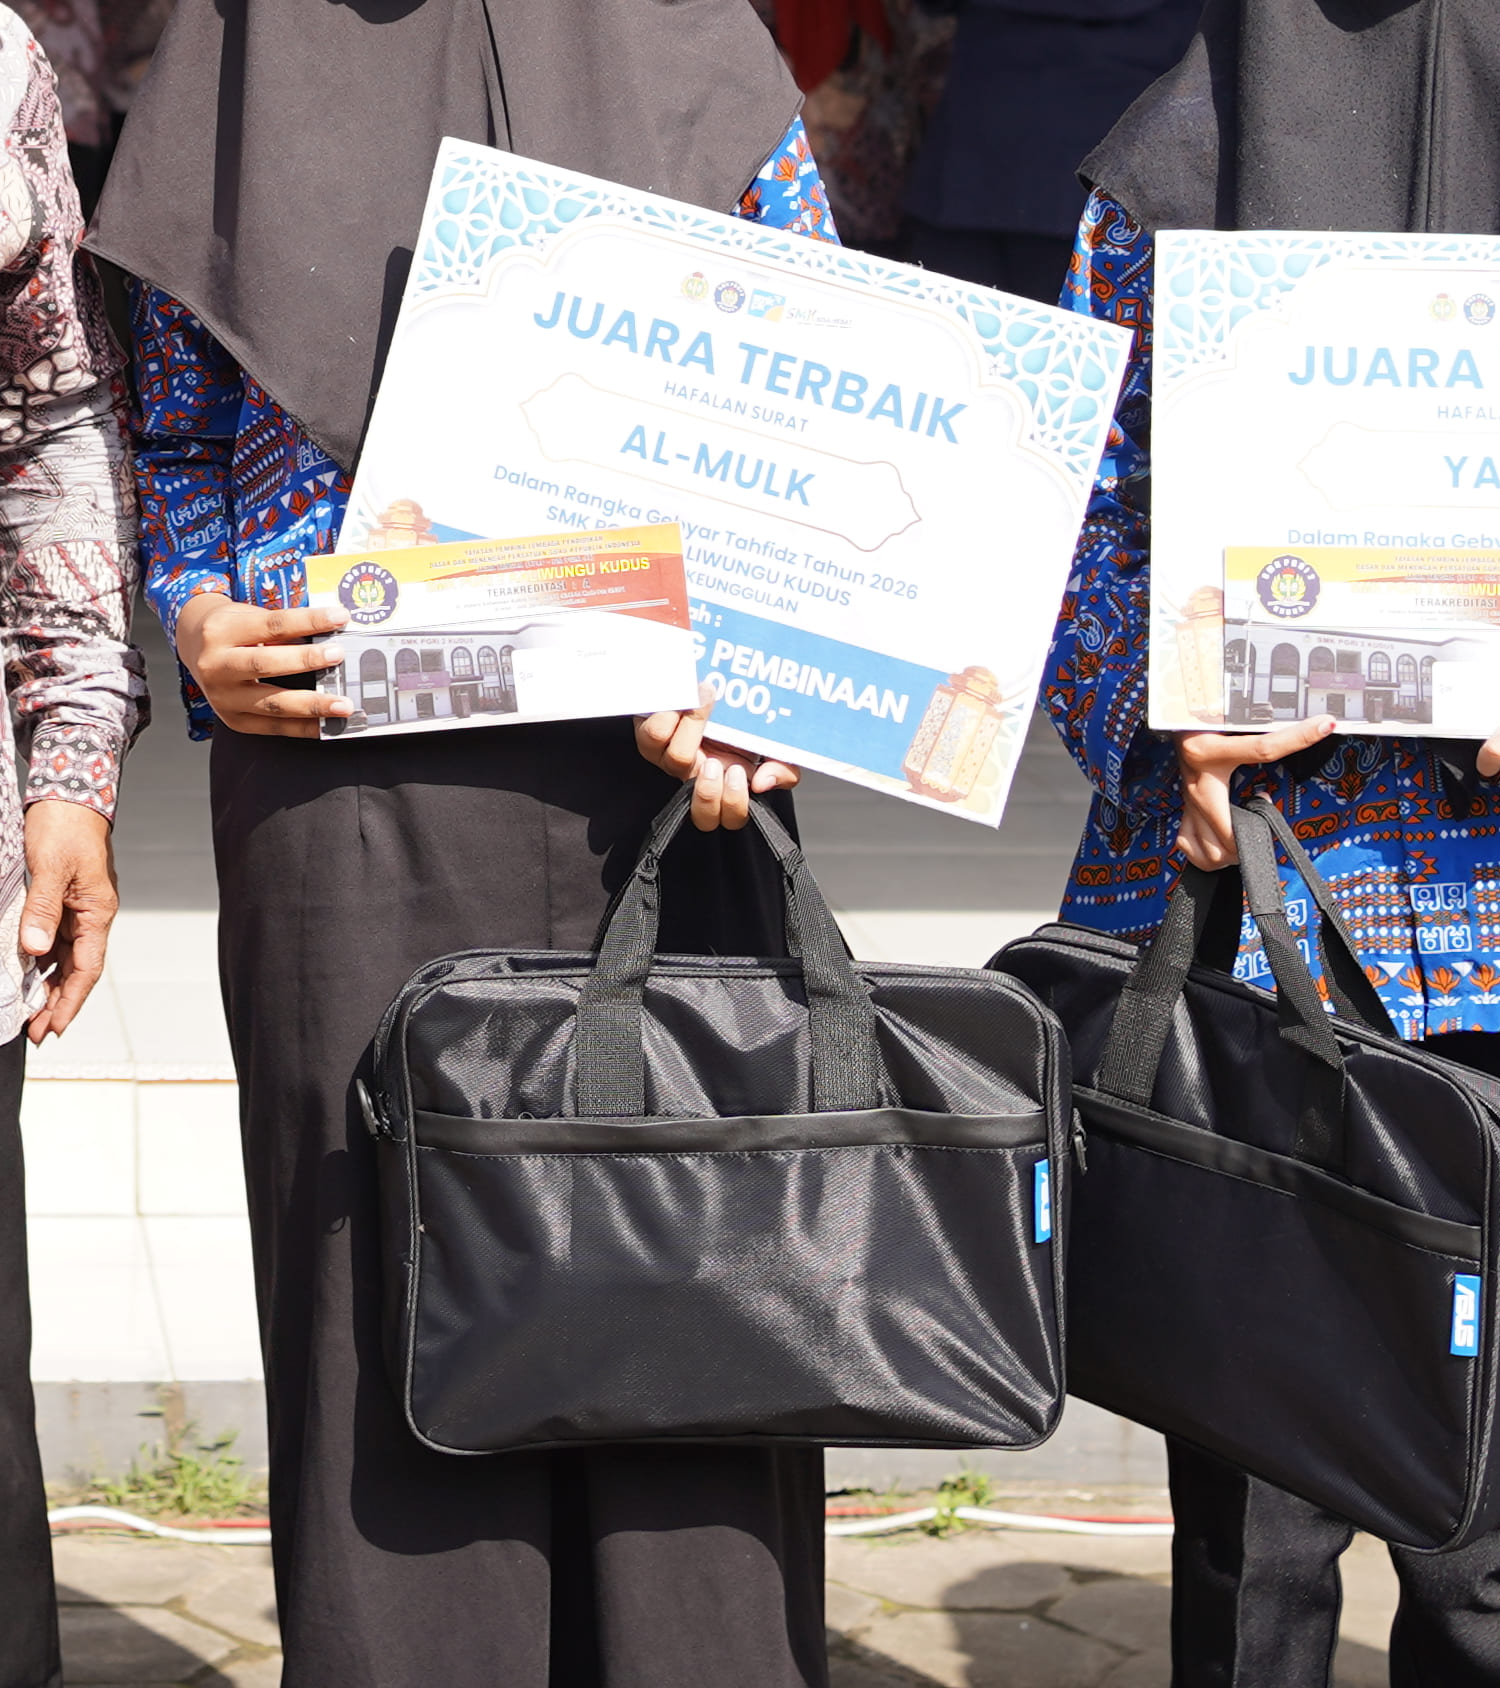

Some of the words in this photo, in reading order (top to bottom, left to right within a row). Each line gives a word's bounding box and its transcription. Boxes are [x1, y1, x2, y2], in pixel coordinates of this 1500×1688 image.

[532, 290, 715, 375] JUARA
[737, 340, 968, 444] TERBAIK
[1286, 345, 1484, 389] JUARA
[663, 380, 748, 415] HAFALAN
[750, 404, 809, 433] SURAT
[619, 424, 816, 506] AL-MULK
[492, 464, 560, 496] Dalam
[558, 481, 649, 529] Rangka
[724, 529, 798, 565] Tahfidz
[803, 552, 865, 585] Tahun
[868, 572, 918, 600] 2026
[544, 502, 593, 533] SMK
[683, 542, 786, 589] LIWUNGU
[782, 572, 851, 606] KUDUS
[1286, 528, 1358, 545] Dalam
[485, 580, 569, 599] TERAKREDITASI
[598, 556, 651, 575] KUDUS
[683, 568, 802, 617] KEUNGGULAN
[1413, 596, 1500, 609] TERAKREDITASI
[708, 637, 910, 724] PEMBINAAN
[1453, 1282, 1476, 1348] ASUS
